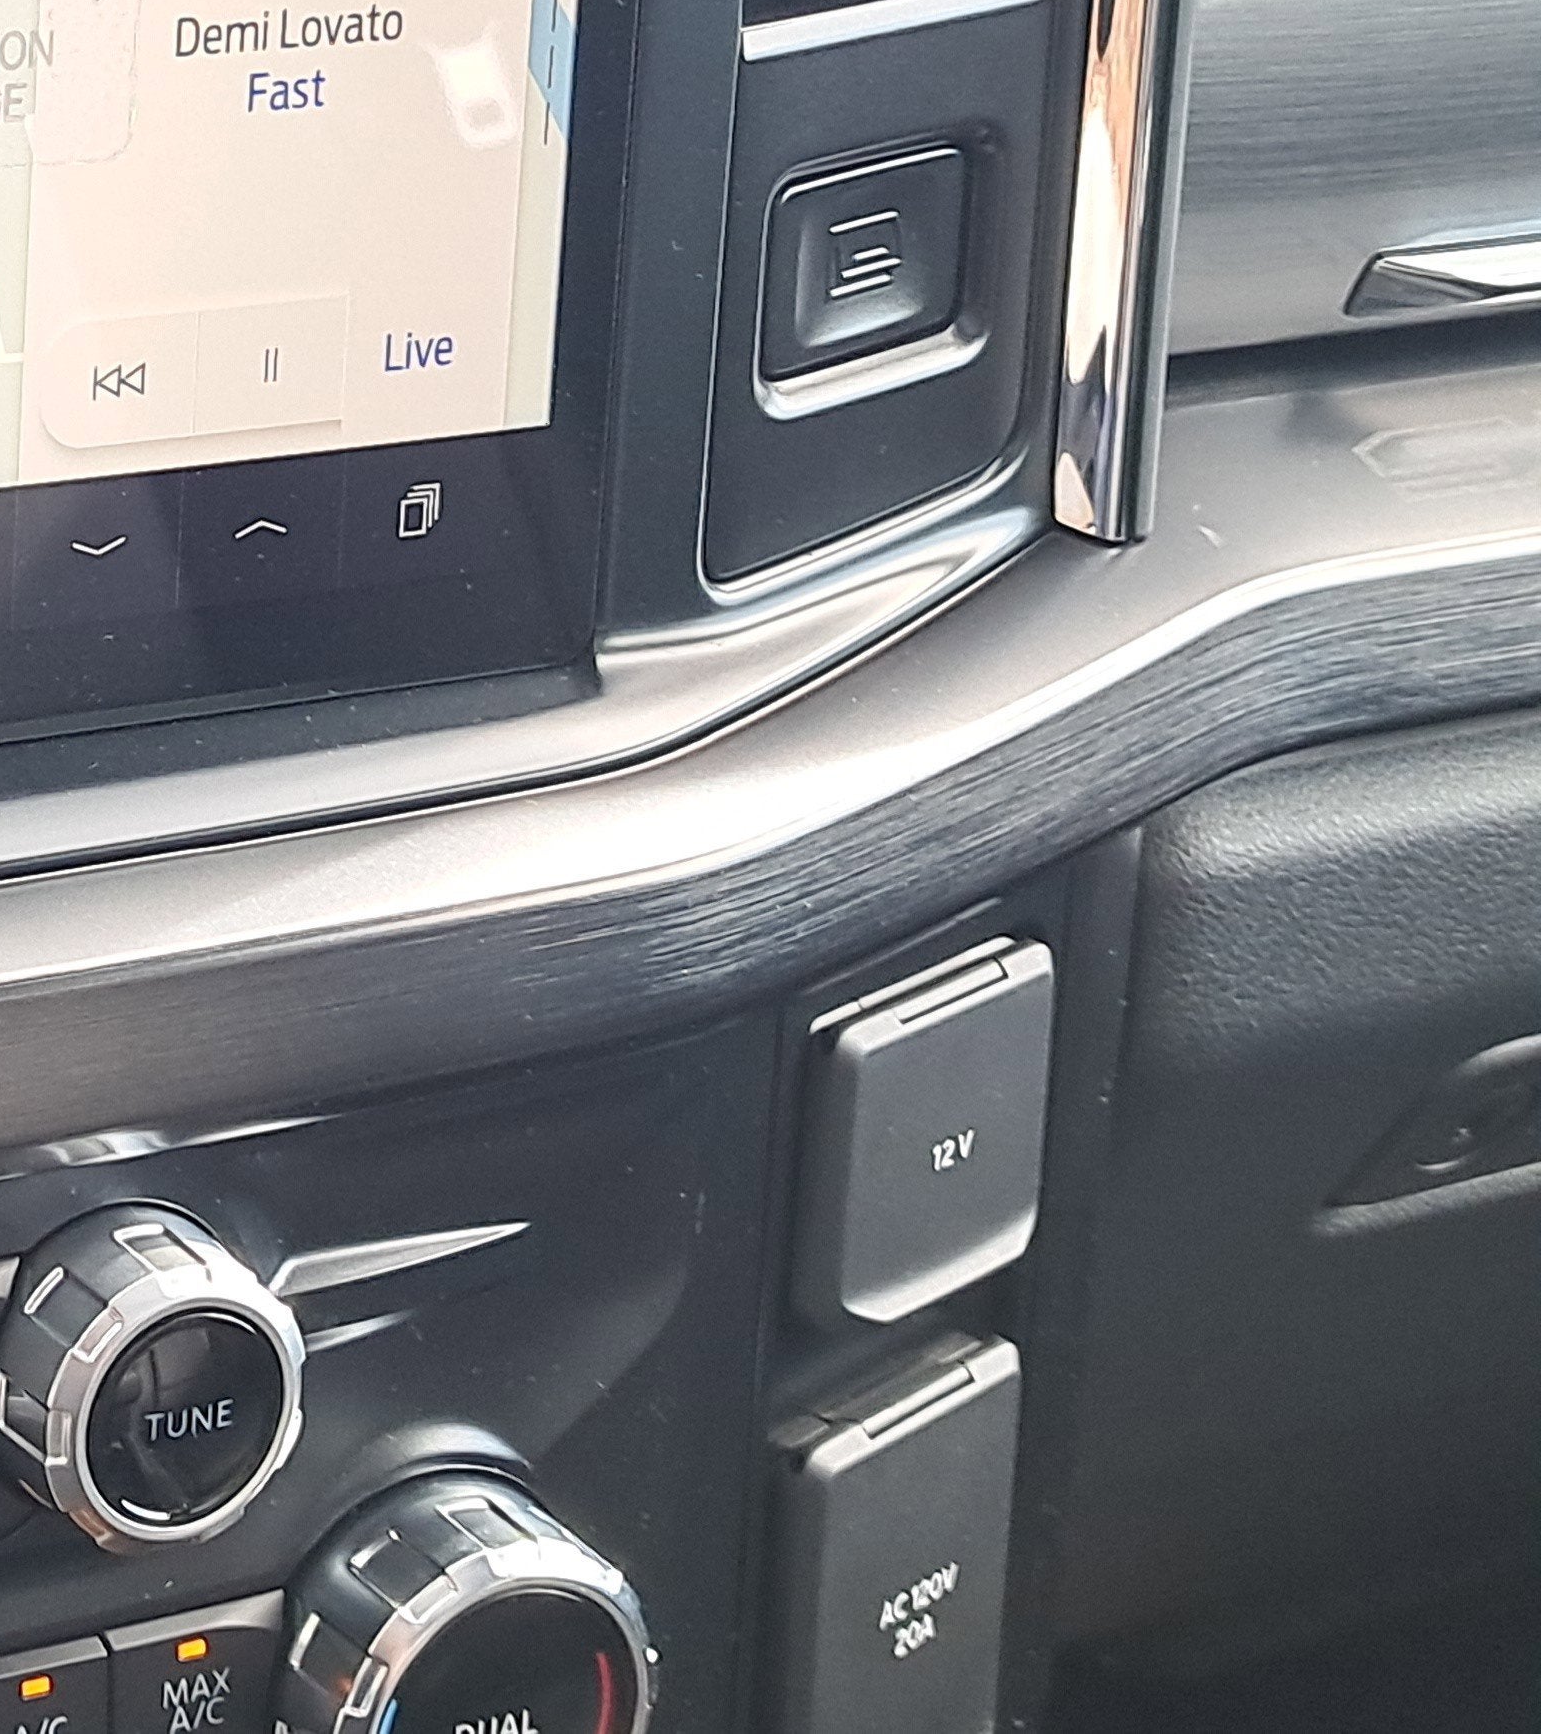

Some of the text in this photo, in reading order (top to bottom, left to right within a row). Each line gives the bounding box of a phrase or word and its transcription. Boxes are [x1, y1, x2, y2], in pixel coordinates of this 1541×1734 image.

[174, 5, 403, 58] Demi Lovato
[247, 71, 326, 112] Fast
[384, 331, 454, 373] Live
[145, 1401, 234, 1441] TUNE
[878, 1591, 909, 1631] AC
[163, 1667, 230, 1709] MAX
[169, 1696, 224, 1734] A/C
